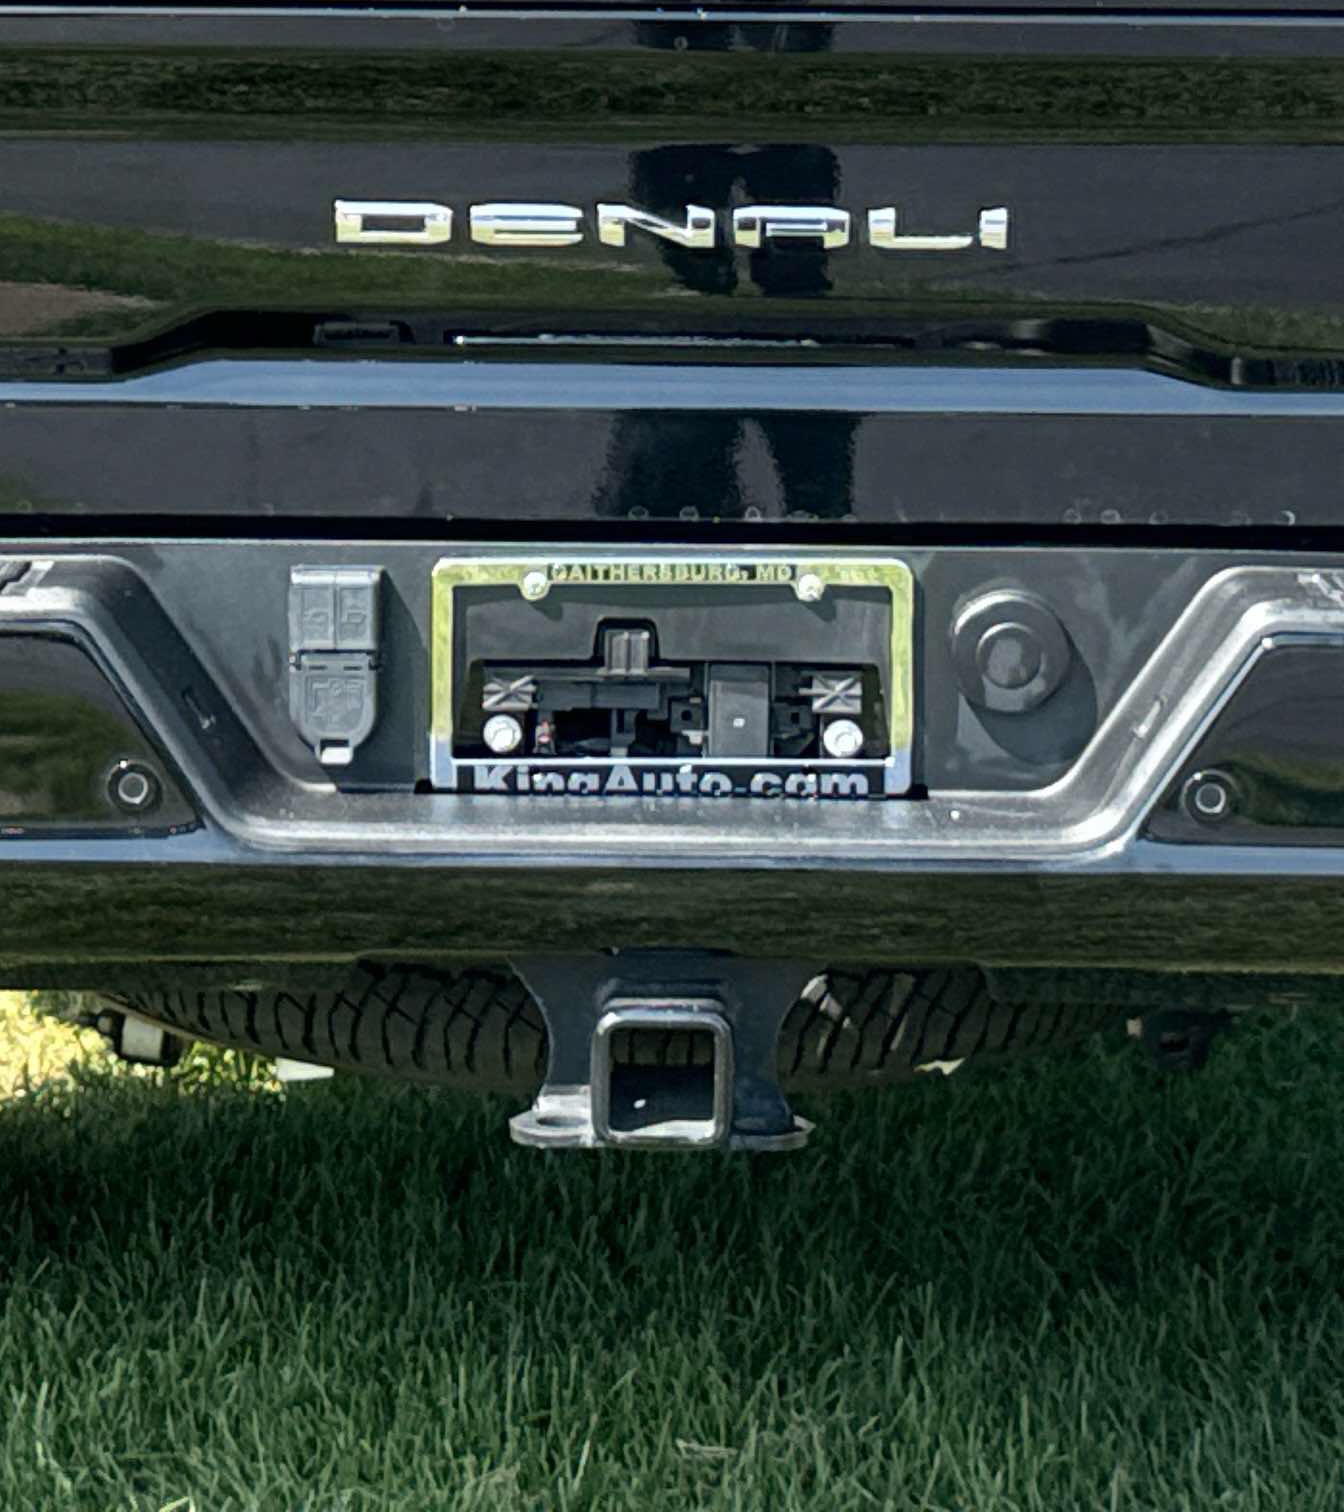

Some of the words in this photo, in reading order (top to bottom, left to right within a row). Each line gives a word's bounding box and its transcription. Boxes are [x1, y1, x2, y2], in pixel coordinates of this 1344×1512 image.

[335, 199, 1009, 249] DENALI
[756, 563, 793, 582] MD
[473, 764, 869, 795] KingAuto.com
